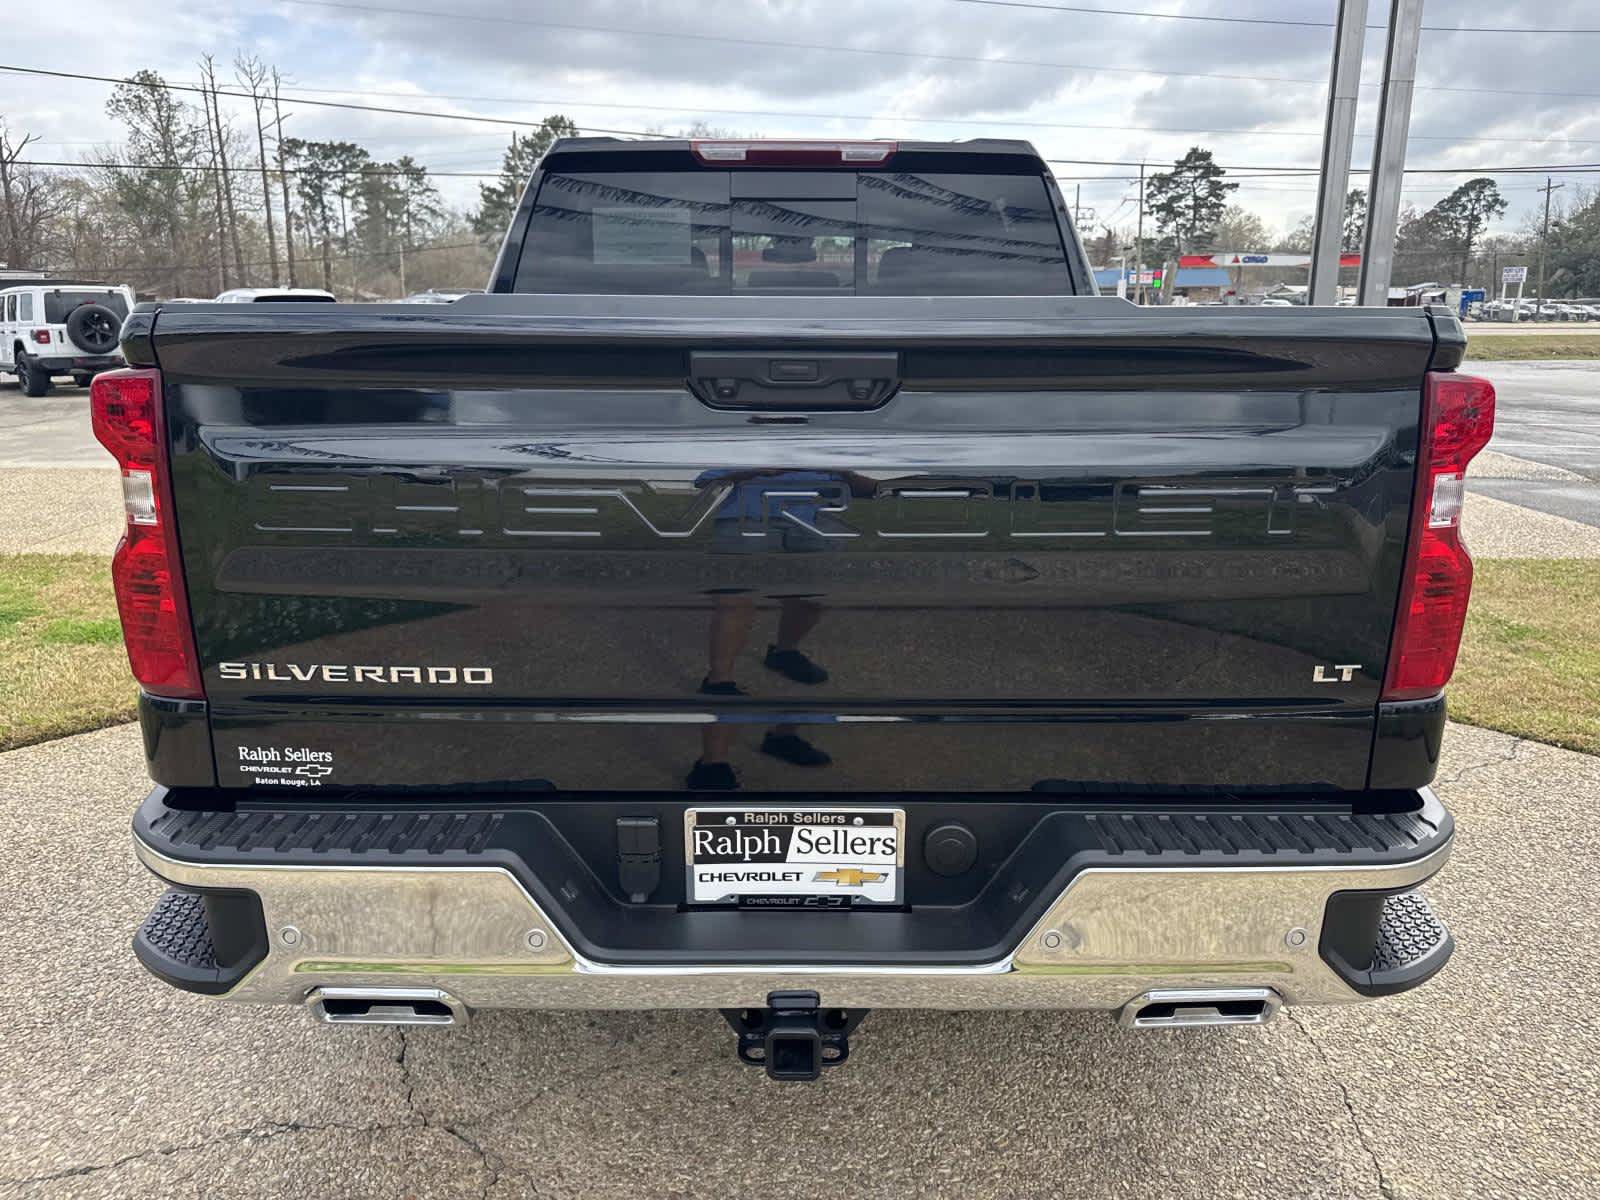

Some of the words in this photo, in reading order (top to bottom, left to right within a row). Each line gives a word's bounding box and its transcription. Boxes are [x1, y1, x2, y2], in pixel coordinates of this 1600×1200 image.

[253, 480, 1340, 538] CHEVROLET
[218, 662, 494, 685] SILVERADO
[1312, 664, 1362, 683] LT
[238, 746, 282, 764] Ralph
[284, 747, 333, 762] Sellers
[239, 765, 293, 774] CHEVROLET
[255, 777, 279, 786] Baton
[280, 777, 309, 787] Rouge,
[310, 778, 321, 786] LA
[744, 812, 788, 826] Ralph
[792, 812, 846, 824] Sellers
[693, 829, 782, 862] Ralph
[796, 828, 896, 856] Sellers
[698, 872, 804, 883] CHEVROLET
[746, 897, 801, 906] CHEVROLET
